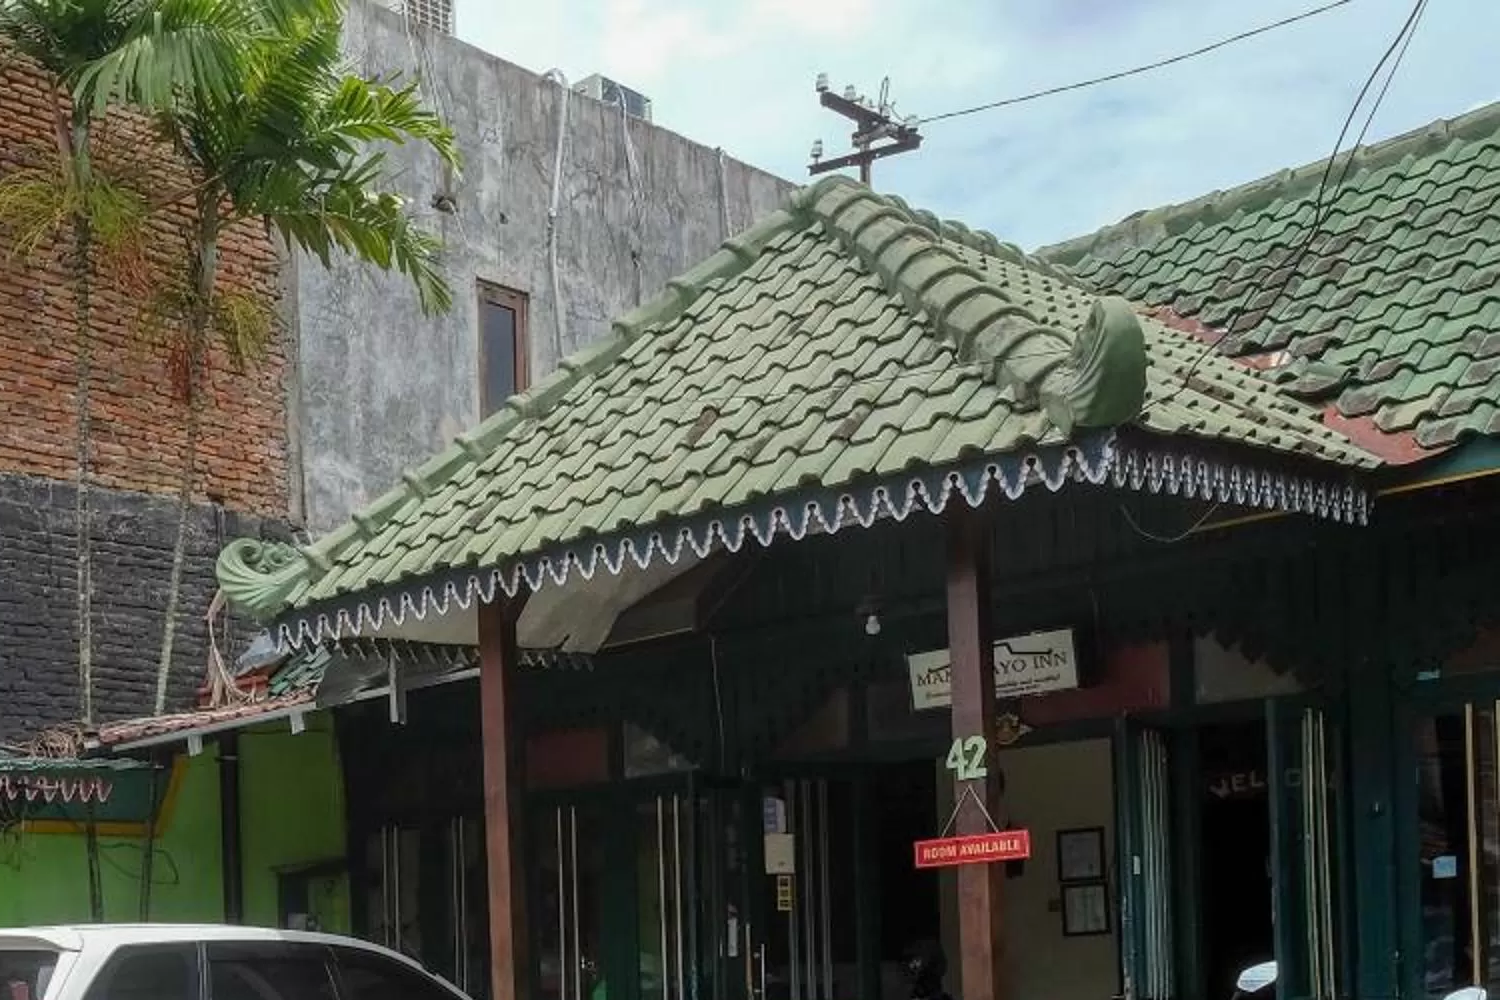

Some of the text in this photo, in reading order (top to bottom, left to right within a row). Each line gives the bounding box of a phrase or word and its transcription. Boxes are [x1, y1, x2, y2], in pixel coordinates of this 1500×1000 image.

[1033, 651, 1067, 669] INN
[946, 736, 987, 780] 42
[923, 839, 1020, 860] ROOM AVAILABLE
